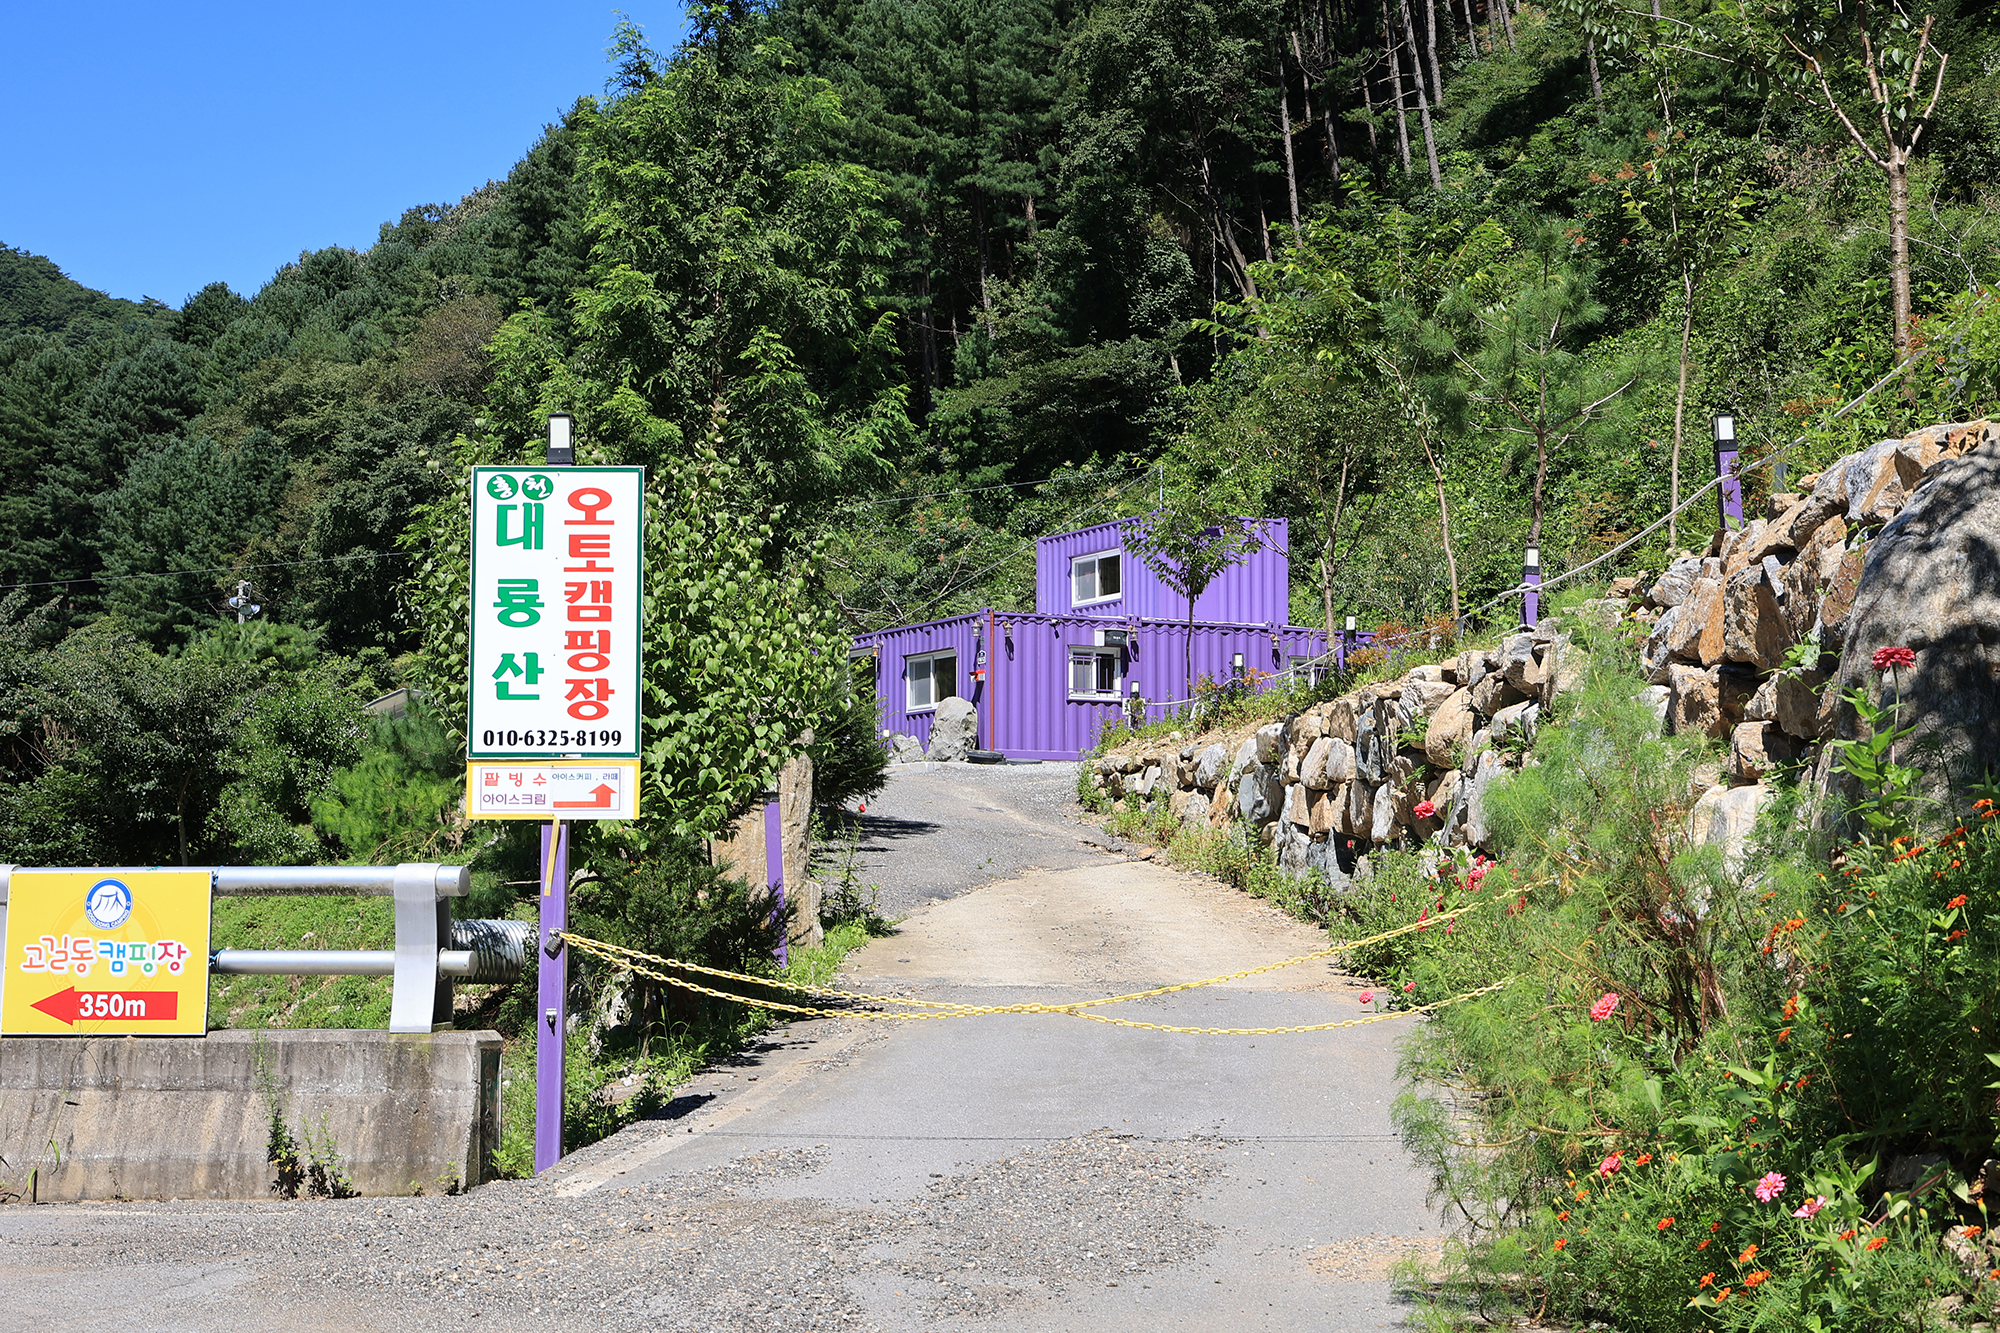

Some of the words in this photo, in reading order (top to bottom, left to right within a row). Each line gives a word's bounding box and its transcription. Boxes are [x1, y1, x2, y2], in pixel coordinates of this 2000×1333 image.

[492, 503, 544, 700] 대룡산
[564, 487, 615, 721] 오토캠핑장
[483, 730, 622, 747] 010-6325-8199
[482, 793, 546, 805] 아이스크림
[22, 935, 95, 974] 고길동
[99, 940, 188, 973] 캠핑장
[79, 993, 146, 1017] 350m
